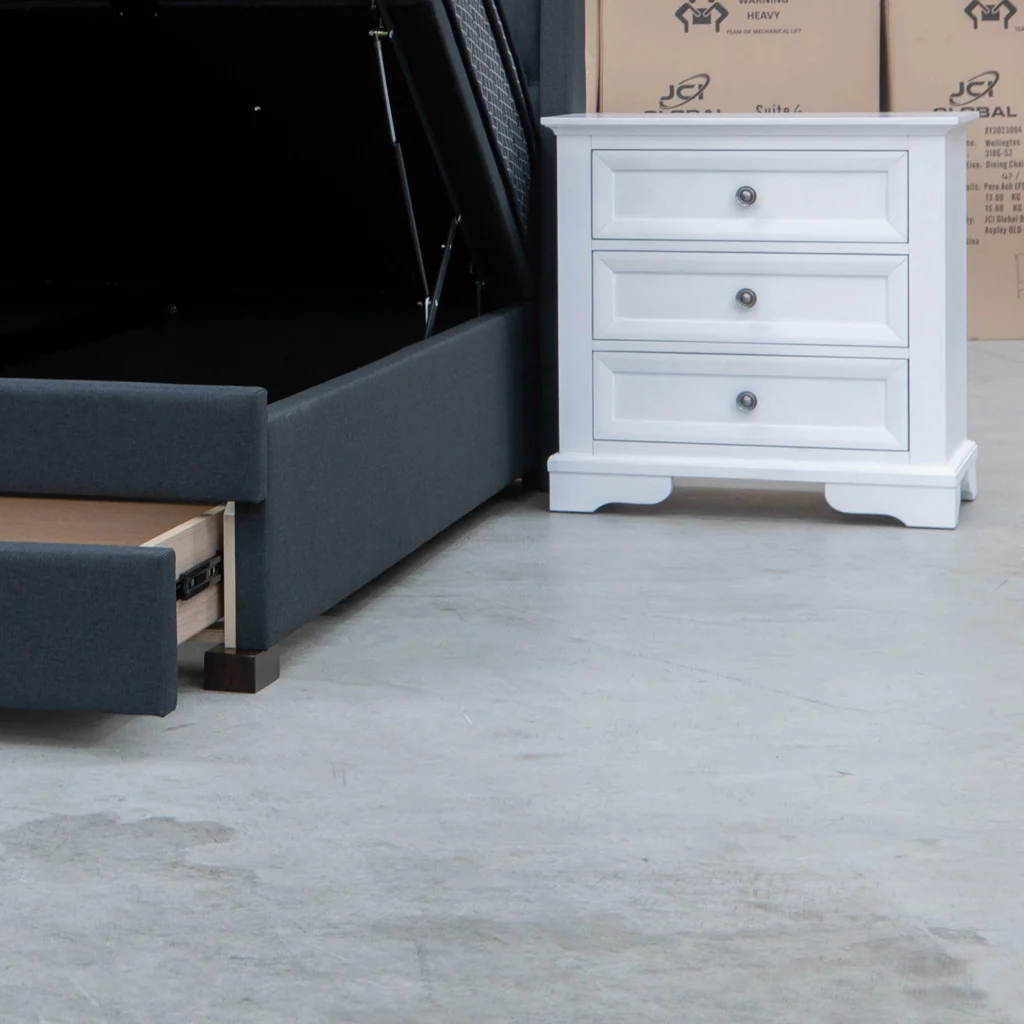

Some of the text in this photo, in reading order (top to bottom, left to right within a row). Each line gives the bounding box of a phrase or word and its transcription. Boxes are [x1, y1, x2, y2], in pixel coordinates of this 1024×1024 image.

[747, 11, 780, 20] HEAVY
[659, 80, 706, 104] JCI
[949, 76, 996, 101] JCI
